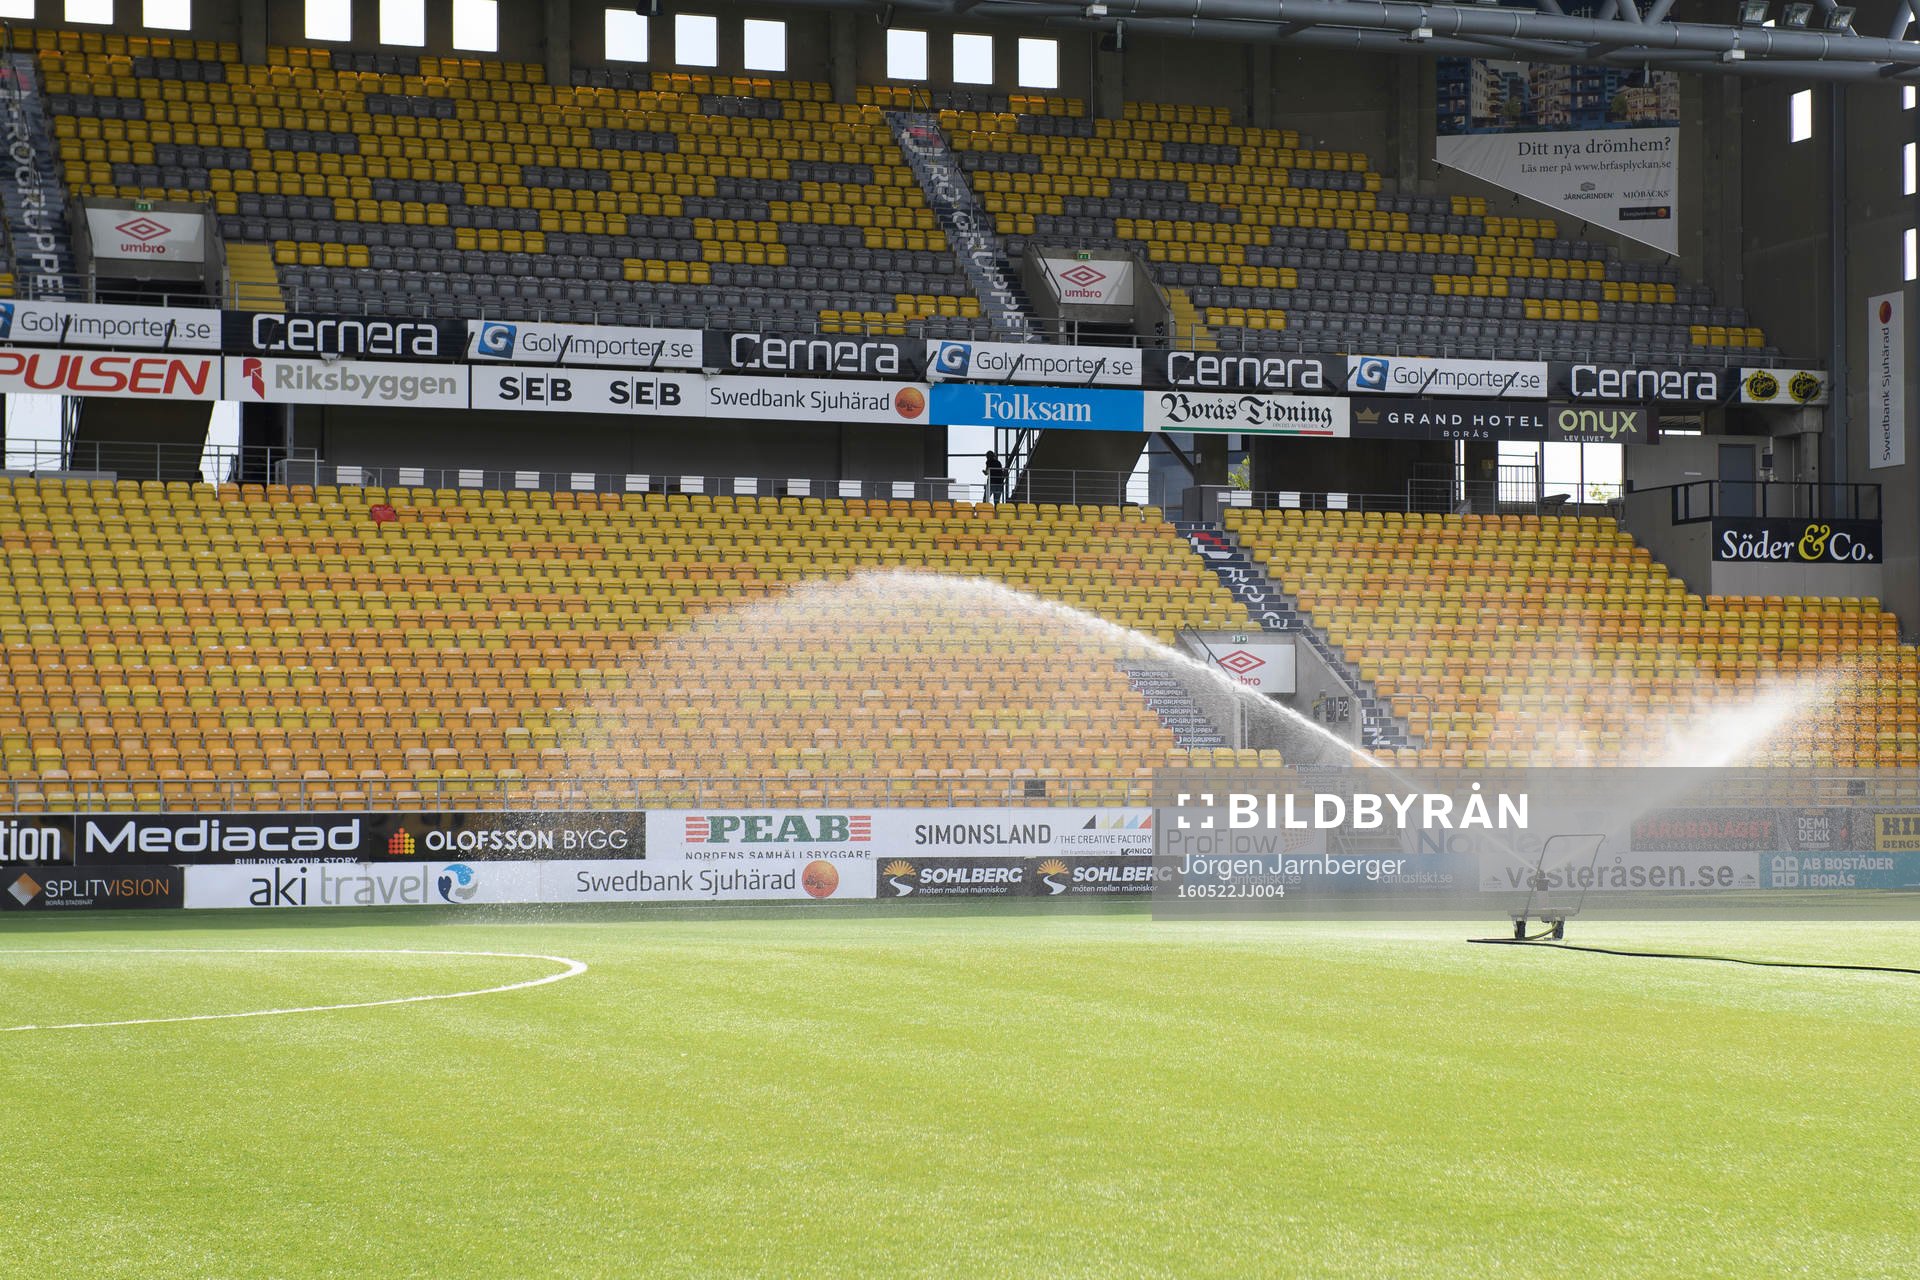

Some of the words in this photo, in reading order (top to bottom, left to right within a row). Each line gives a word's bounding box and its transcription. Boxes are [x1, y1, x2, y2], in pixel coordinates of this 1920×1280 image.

[1518, 141, 1549, 156] Ditt
[1553, 143, 1581, 159] nya
[1585, 137, 1671, 154] drömhem?
[1521, 163, 1538, 173] Läs
[1539, 163, 1558, 173] mer
[1560, 162, 1572, 174] på
[1574, 159, 1672, 173] www.brfasplyckan.se
[120, 243, 166, 254] umbro
[1065, 289, 1102, 298] umbro
[21, 311, 211, 339] Golvimporten.se
[252, 313, 438, 356] Cernera
[522, 332, 693, 359] Golvimporten.se
[731, 333, 899, 374] Cernera
[1882, 327, 1892, 387] Sjuhärad
[976, 351, 1133, 377] Golvimporten.se
[1167, 352, 1323, 390] Cernera
[275, 364, 457, 399] Riksbyggen
[499, 376, 573, 401] SEB
[1393, 366, 1540, 390] Golvimporten.se
[1571, 365, 1717, 400] Cernera
[609, 380, 682, 406] SEB
[710, 387, 805, 408] Swedbank
[811, 391, 890, 413] Sjuhärad
[982, 393, 1092, 422] Folksam
[1161, 393, 1236, 423] Borås
[1238, 396, 1333, 428] Tidning
[1388, 413, 1466, 425] GRAND
[1473, 416, 1544, 427] HOTEL
[1443, 429, 1489, 439] BORÅS
[1559, 409, 1638, 440] onyx
[1882, 390, 1891, 461] Swedbank
[1721, 529, 1795, 560] Söder
[1798, 524, 1831, 561] &
[1829, 532, 1874, 561] Co.
[86, 819, 360, 852] Mediacad
[706, 815, 850, 843] PEAB
[915, 825, 1051, 844] SIMONSLAND
[1798, 817, 1829, 829] DEMI
[1798, 829, 1830, 842] DEKK
[425, 829, 553, 850] OLOFSSON
[563, 829, 628, 850] BYGG
[1060, 835, 1076, 844] THE
[1078, 834, 1116, 844] CREATIVE
[1118, 834, 1152, 843] FACTORY
[1166, 828, 1278, 854] ProFlow
[685, 851, 745, 860] NORDENS
[749, 849, 871, 859] SAMHÄLLSBYGGARE
[1802, 857, 1821, 870] AB
[1824, 854, 1893, 870] BOSTÄDER
[250, 867, 307, 906] aki
[320, 865, 428, 904] travel
[577, 869, 693, 893] Swedbank
[699, 868, 796, 896] Sjuhärad
[920, 867, 1024, 883] SOHLBERG
[1072, 866, 1172, 882] SOHLBERG
[1803, 873, 1806, 886] I
[1810, 872, 1856, 887] BORÅS
[45, 879, 169, 898] SPLITVISION
[919, 886, 943, 894] möten
[945, 886, 968, 894] mellan
[971, 885, 1007, 894] människor
[1096, 884, 1119, 892] mellan
[1122, 884, 1158, 892] människor
